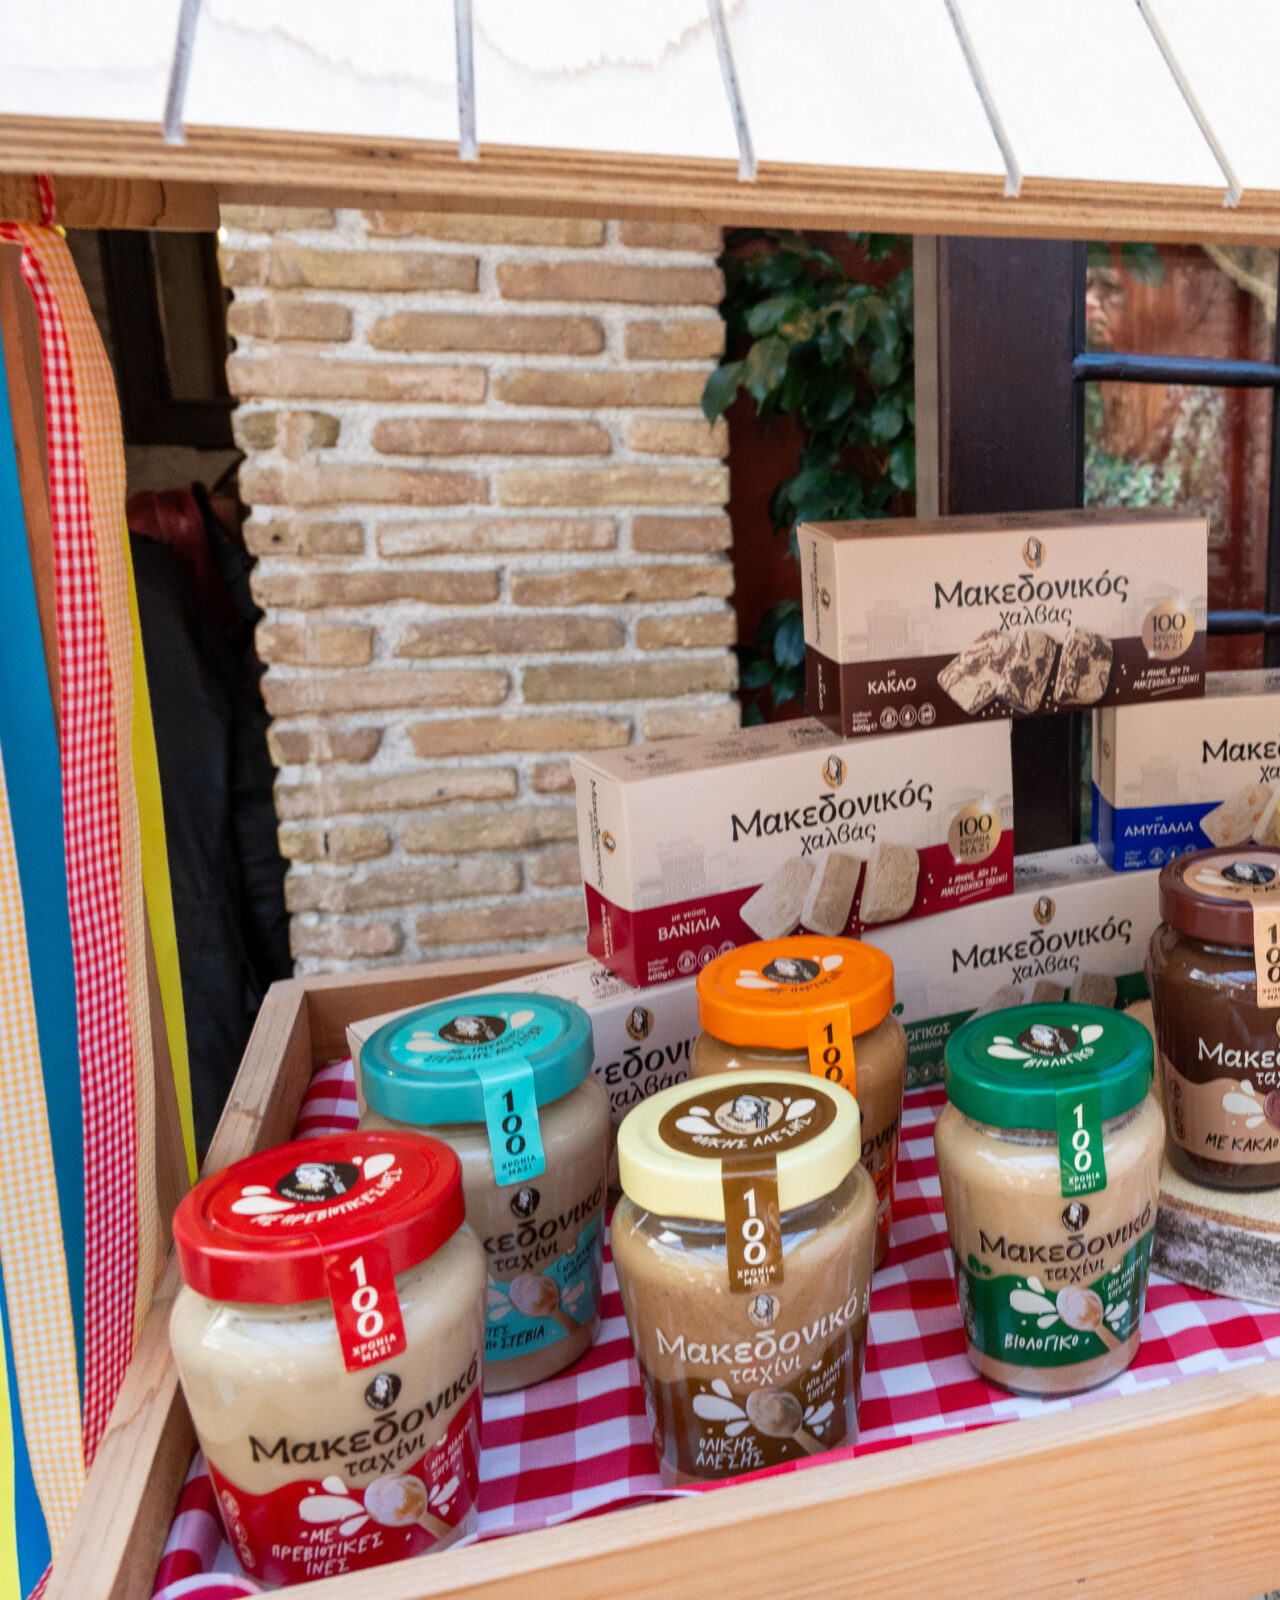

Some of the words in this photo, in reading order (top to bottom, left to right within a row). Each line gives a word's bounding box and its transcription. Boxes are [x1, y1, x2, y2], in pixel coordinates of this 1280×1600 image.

[934, 570, 1129, 611] Μακεδονικός
[1000, 605, 1072, 630] χαλβάς
[1153, 612, 1186, 633] 100
[1153, 641, 1183, 651] ΜΑΖΙ
[868, 677, 917, 695] ΚΑΚΑΟ
[731, 779, 933, 842] Μακεδονικός
[958, 814, 992, 837] 100
[1124, 821, 1194, 837] ΑΜΥΓΔΑΛΑ
[800, 822, 876, 856] χαλβάς
[960, 843, 989, 855] ΜΑΖΙ
[658, 915, 720, 942] ΒΑΝΙΛΙΑ
[952, 916, 1132, 973] Μακεδονικός
[1012, 954, 1080, 985] χαλβάς
[906, 1022, 950, 1042] ΟΓΙΚΟΣ
[823, 1022, 843, 1083] 100
[502, 1089, 526, 1155] 100
[1072, 1103, 1092, 1172] 100
[1206, 1133, 1228, 1149] ΜΕ
[1232, 1137, 1279, 1152] ΚΑΚΑΟ
[501, 1155, 536, 1170] ΧΡΟΝΙΑ
[508, 1164, 533, 1177] ΜΑΖΙ
[1069, 1172, 1100, 1186] ΧΡΟΝΙΑ
[1075, 1181, 1096, 1191] ΜΑΖΙ
[742, 1188, 767, 1266] 100
[979, 1202, 1151, 1263] Μακεδονικό
[494, 1241, 559, 1273] ταχίνι
[737, 1266, 776, 1279] ΧΡΟΝΙΑ
[744, 1276, 770, 1287] ΜΑΖΙ
[1044, 1259, 1104, 1283] ταχίνι
[350, 1255, 384, 1338] 100
[501, 1326, 545, 1350] ΣΤΕΒΙΑ
[656, 1288, 858, 1365] Μακεδονικό
[352, 1333, 397, 1356] ΧΡΟΝΙΑ
[1005, 1333, 1079, 1351] ΒΙΟΛΟΓΙΚΟ
[361, 1346, 392, 1363] ΜΑΖΙ
[730, 1355, 801, 1387] ταχίνι
[249, 1351, 478, 1465] Μακεδονικό
[344, 1433, 426, 1477] ταχίνι
[699, 1436, 758, 1451] ΟΛΙΚΗΣ
[696, 1451, 765, 1470] ΑΛΕΣΗΣ
[310, 1526, 336, 1543] ΜΕ
[271, 1532, 383, 1563] ΠΡΕΒΙΟΤΙΚΕΣ
[306, 1557, 350, 1577] ΙΝΕΣ
